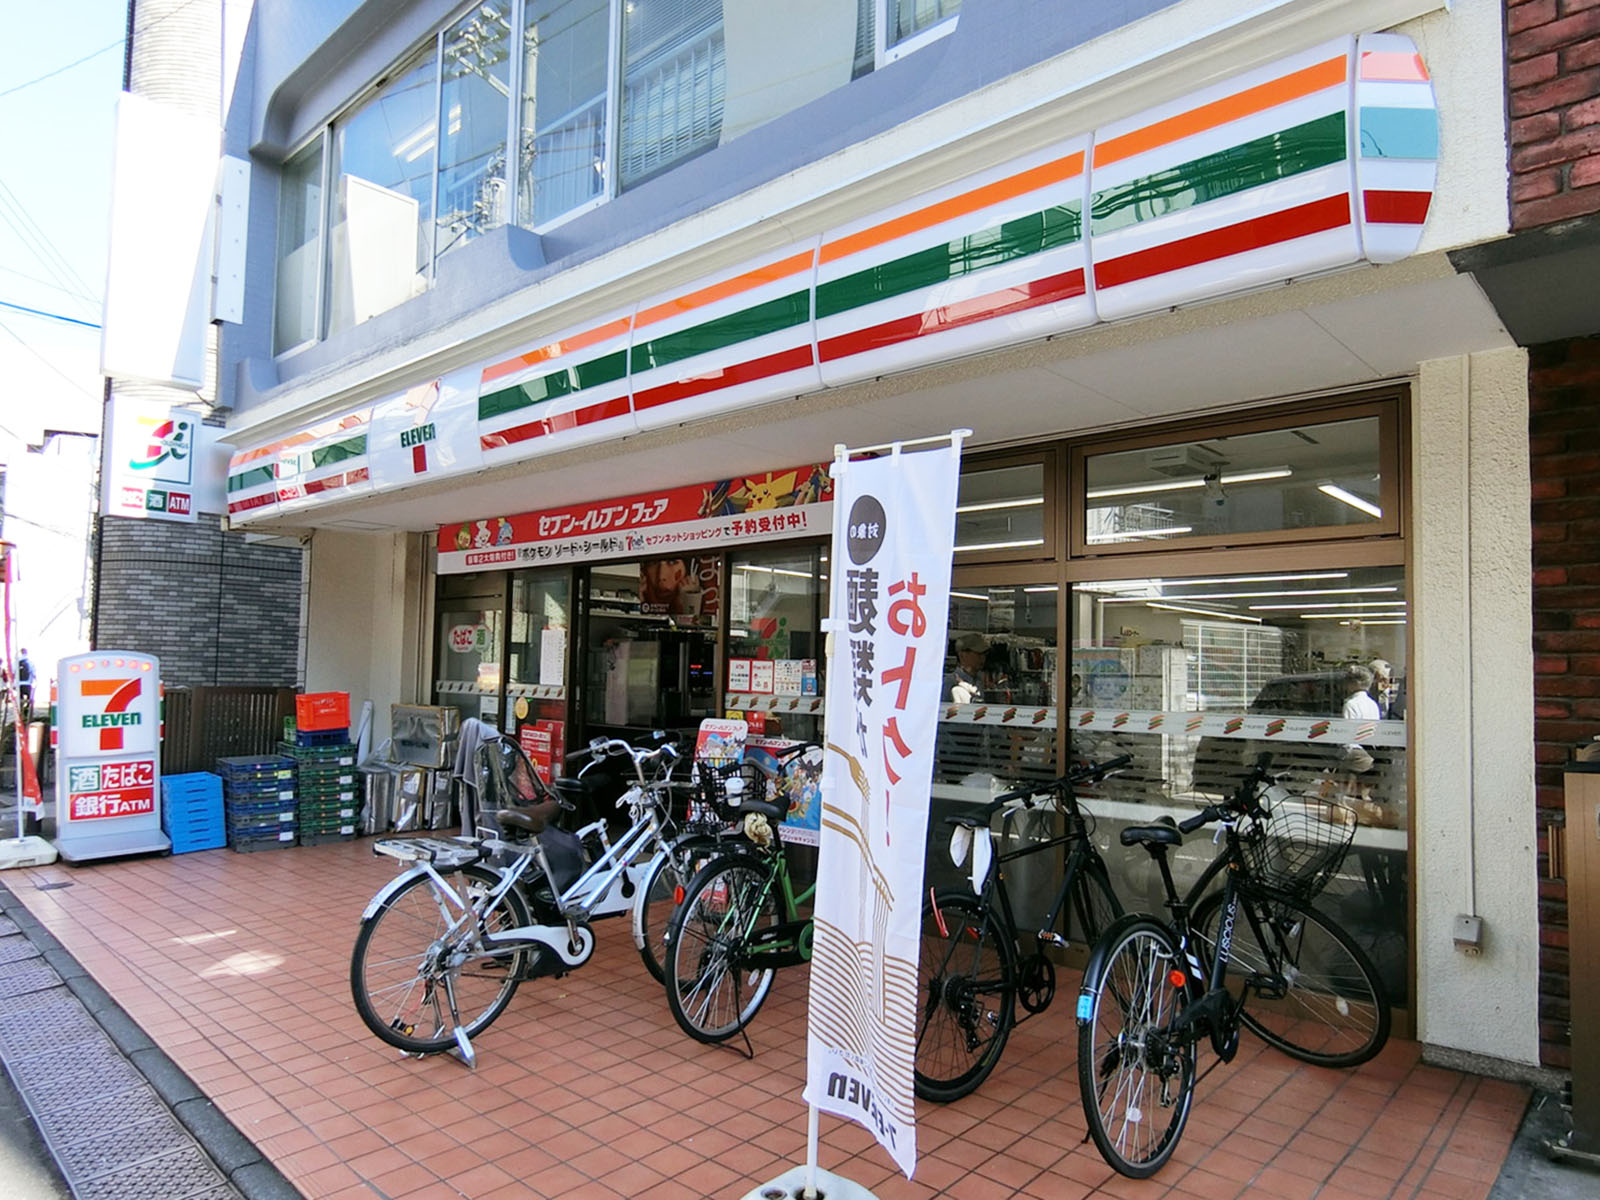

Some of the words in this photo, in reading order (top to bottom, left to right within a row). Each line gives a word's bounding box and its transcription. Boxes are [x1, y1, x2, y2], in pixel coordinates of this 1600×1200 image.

[169, 496, 190, 511] ATM
[72, 768, 99, 791] 酒
[103, 764, 153, 789] たばこ
[75, 794, 150, 816] 銀行ATM
[1219, 903, 1236, 962] LUSCIOUS
